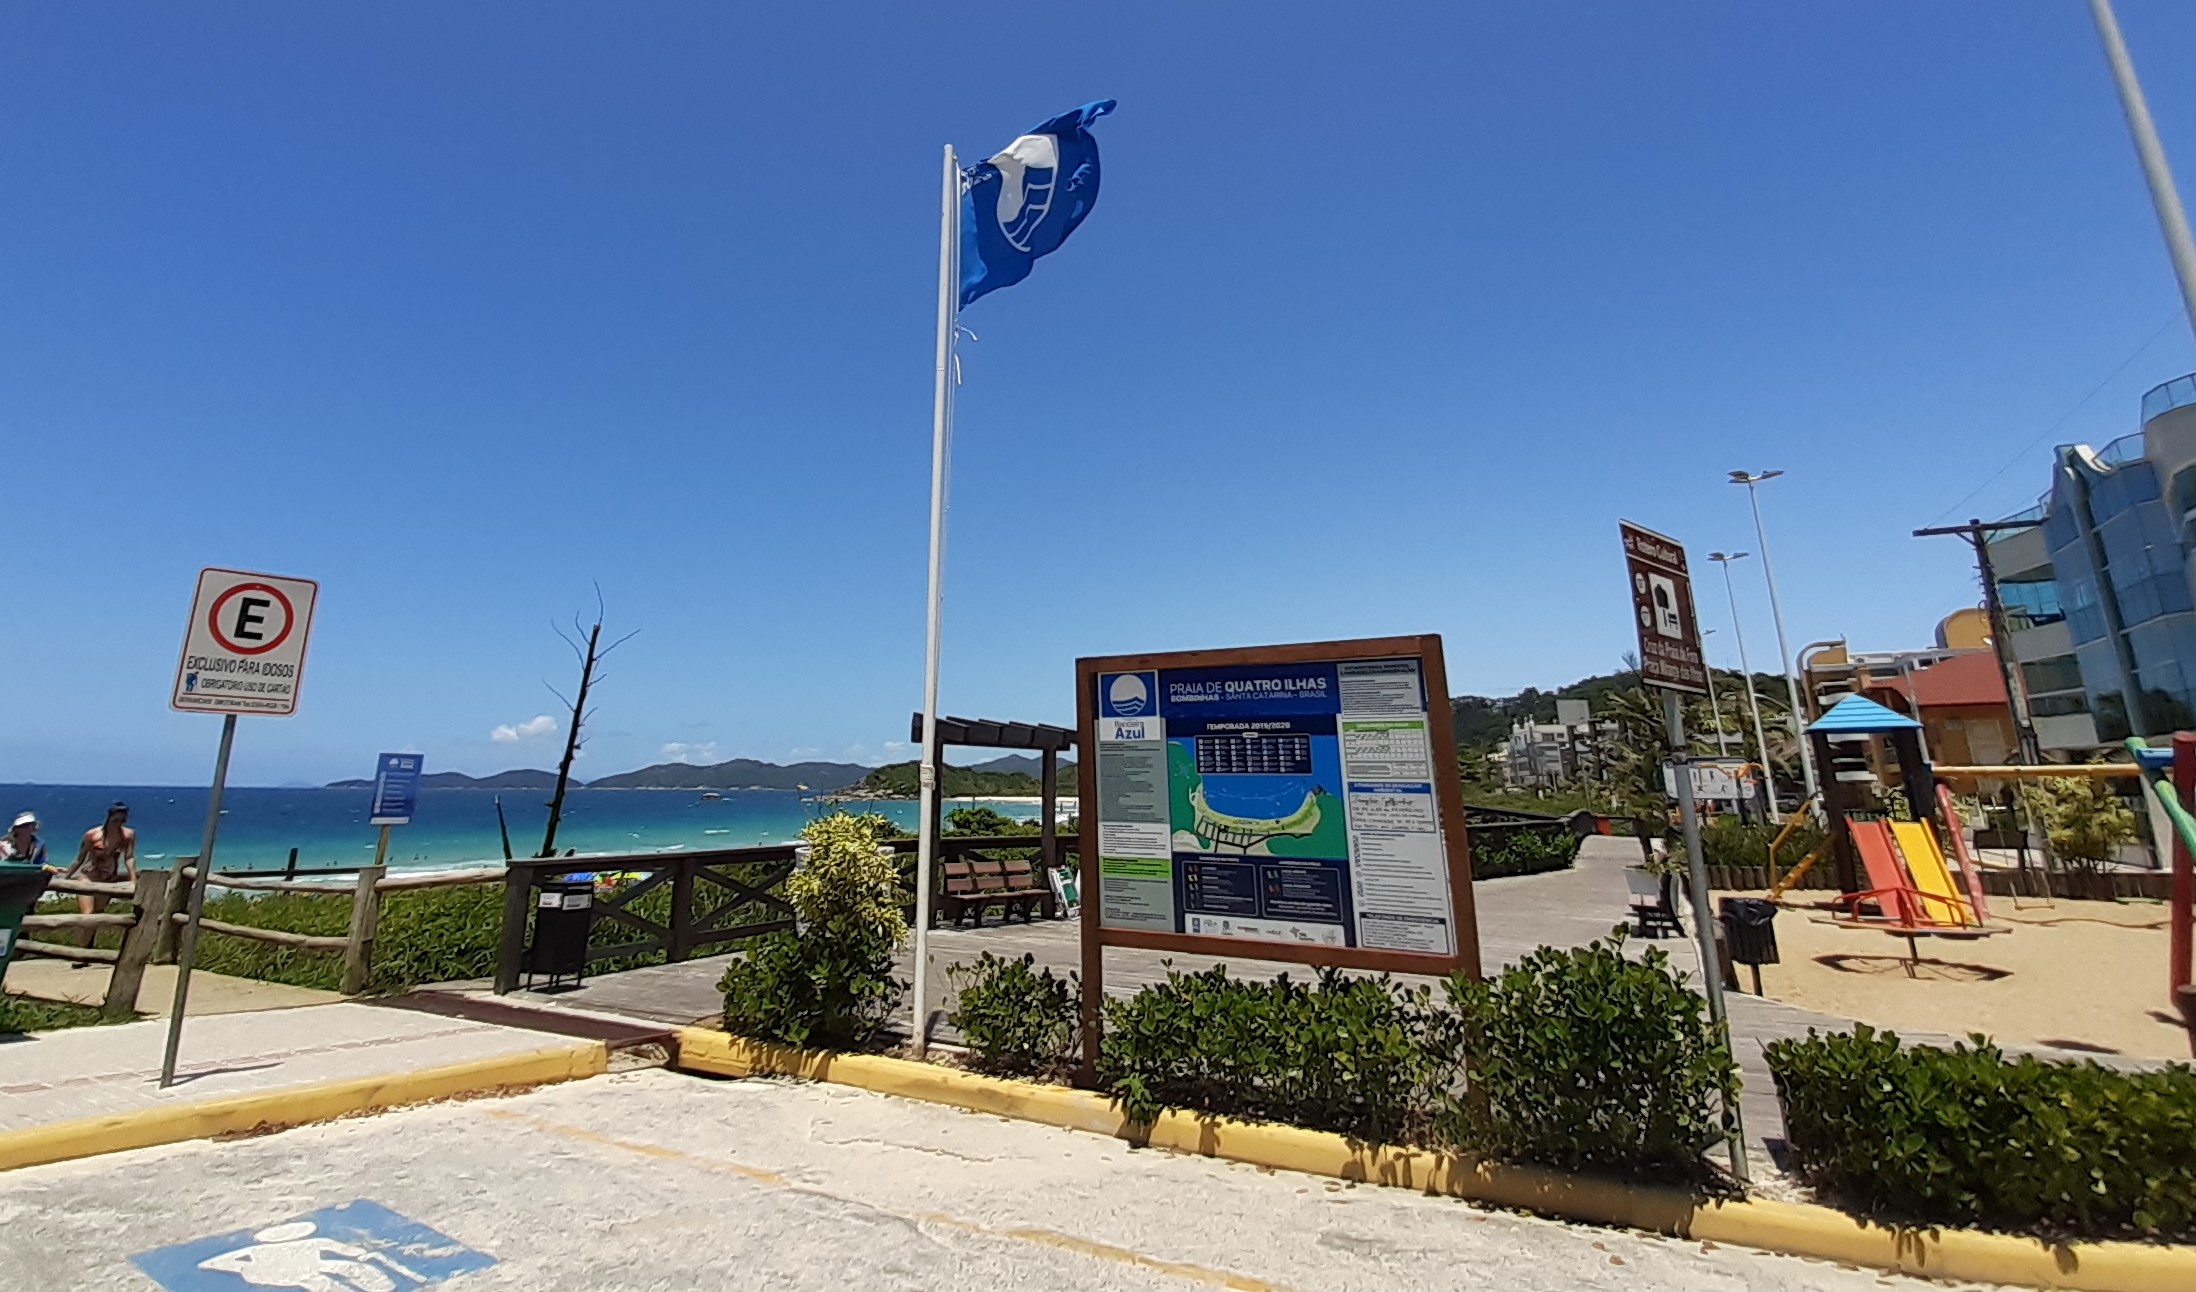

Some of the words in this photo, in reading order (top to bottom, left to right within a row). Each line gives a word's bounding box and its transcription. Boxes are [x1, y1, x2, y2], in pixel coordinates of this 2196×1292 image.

[234, 597, 271, 641] E
[186, 656, 237, 673] EXCLUSIVO
[237, 658, 260, 675] PARA
[262, 662, 295, 678] IDOSOS
[1169, 682, 1203, 694] PRAIA
[1206, 682, 1222, 693] DE
[1224, 679, 1282, 692] QUATRO
[1284, 677, 1328, 690] ILHAS
[1226, 692, 1251, 701] SANTA
[1252, 691, 1293, 700] CATARINA
[1299, 690, 1328, 698] BRASIL
[1115, 727, 1145, 740] Azul
[1206, 723, 1250, 731] TEMPORADA
